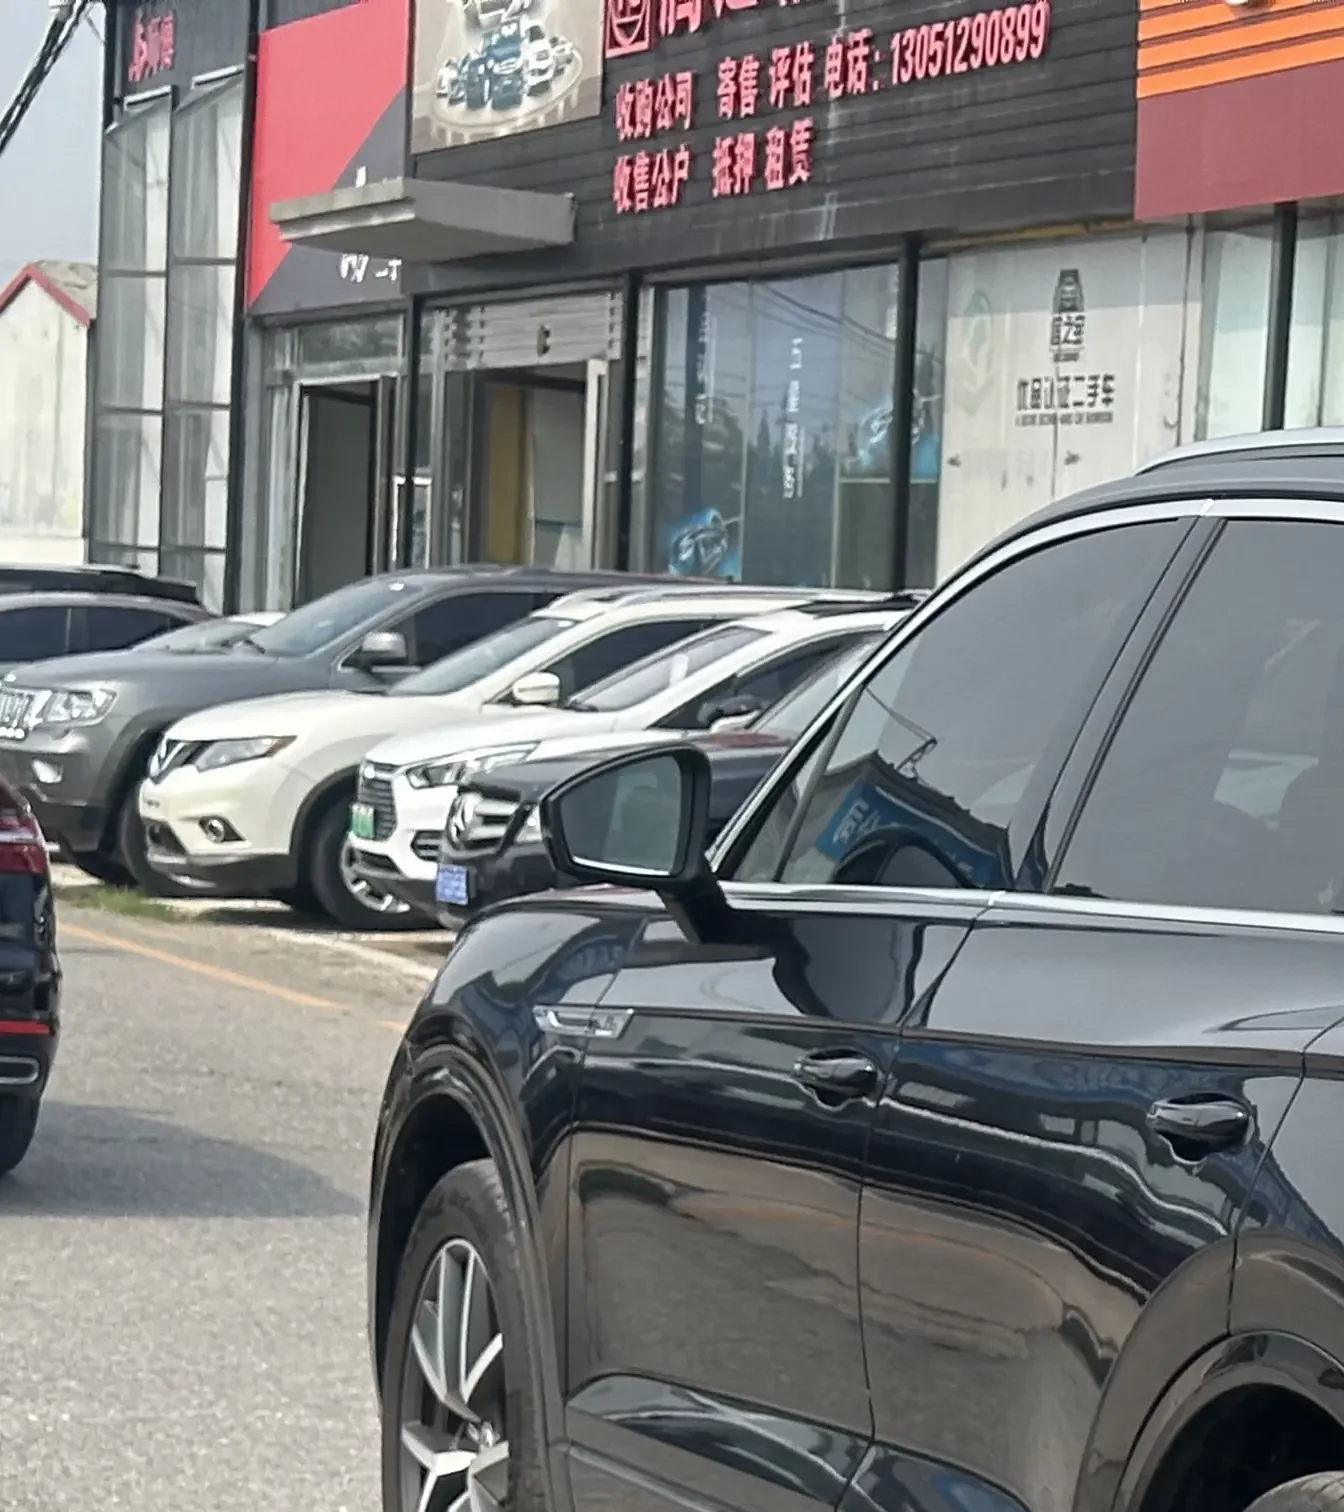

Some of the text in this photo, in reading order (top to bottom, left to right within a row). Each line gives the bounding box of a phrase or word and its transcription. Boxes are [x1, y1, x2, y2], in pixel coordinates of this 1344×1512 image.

[616, 71, 693, 142] 收购公司
[717, 55, 760, 120] 寄售
[769, 41, 814, 109] 评估
[764, 117, 814, 190] 租赁
